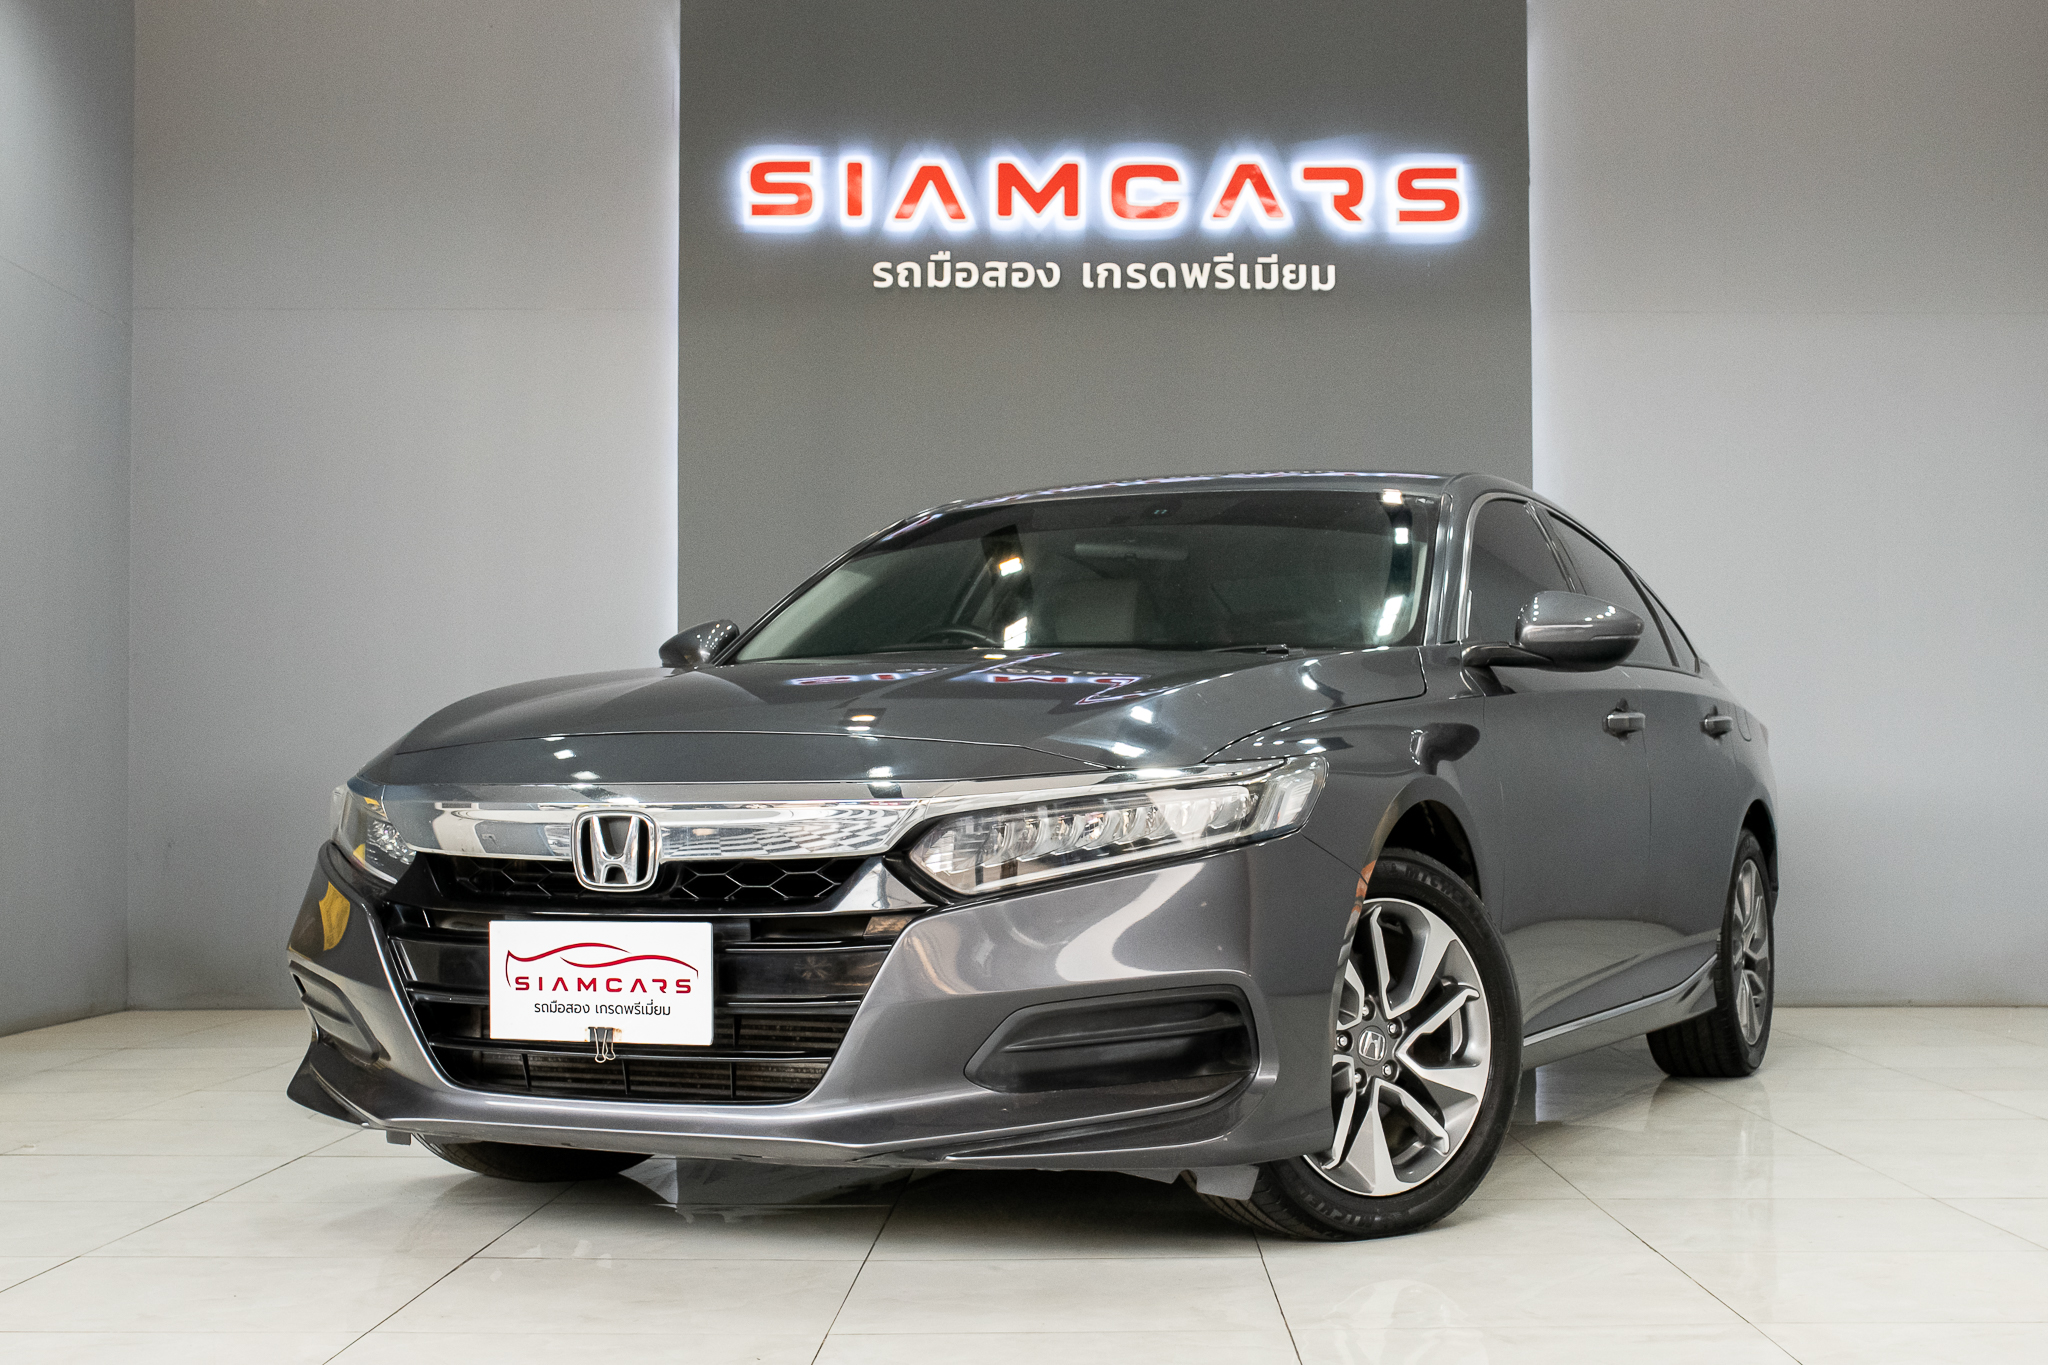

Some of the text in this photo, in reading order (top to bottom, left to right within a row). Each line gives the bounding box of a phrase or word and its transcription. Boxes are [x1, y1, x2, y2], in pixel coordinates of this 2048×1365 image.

[750, 160, 1460, 222] SIAMCARS
[872, 250, 1337, 291] รถมือสอง เกรดพรีเมียม
[514, 976, 692, 994] SIAMCARS
[534, 1000, 590, 1014] รถมือสอง
